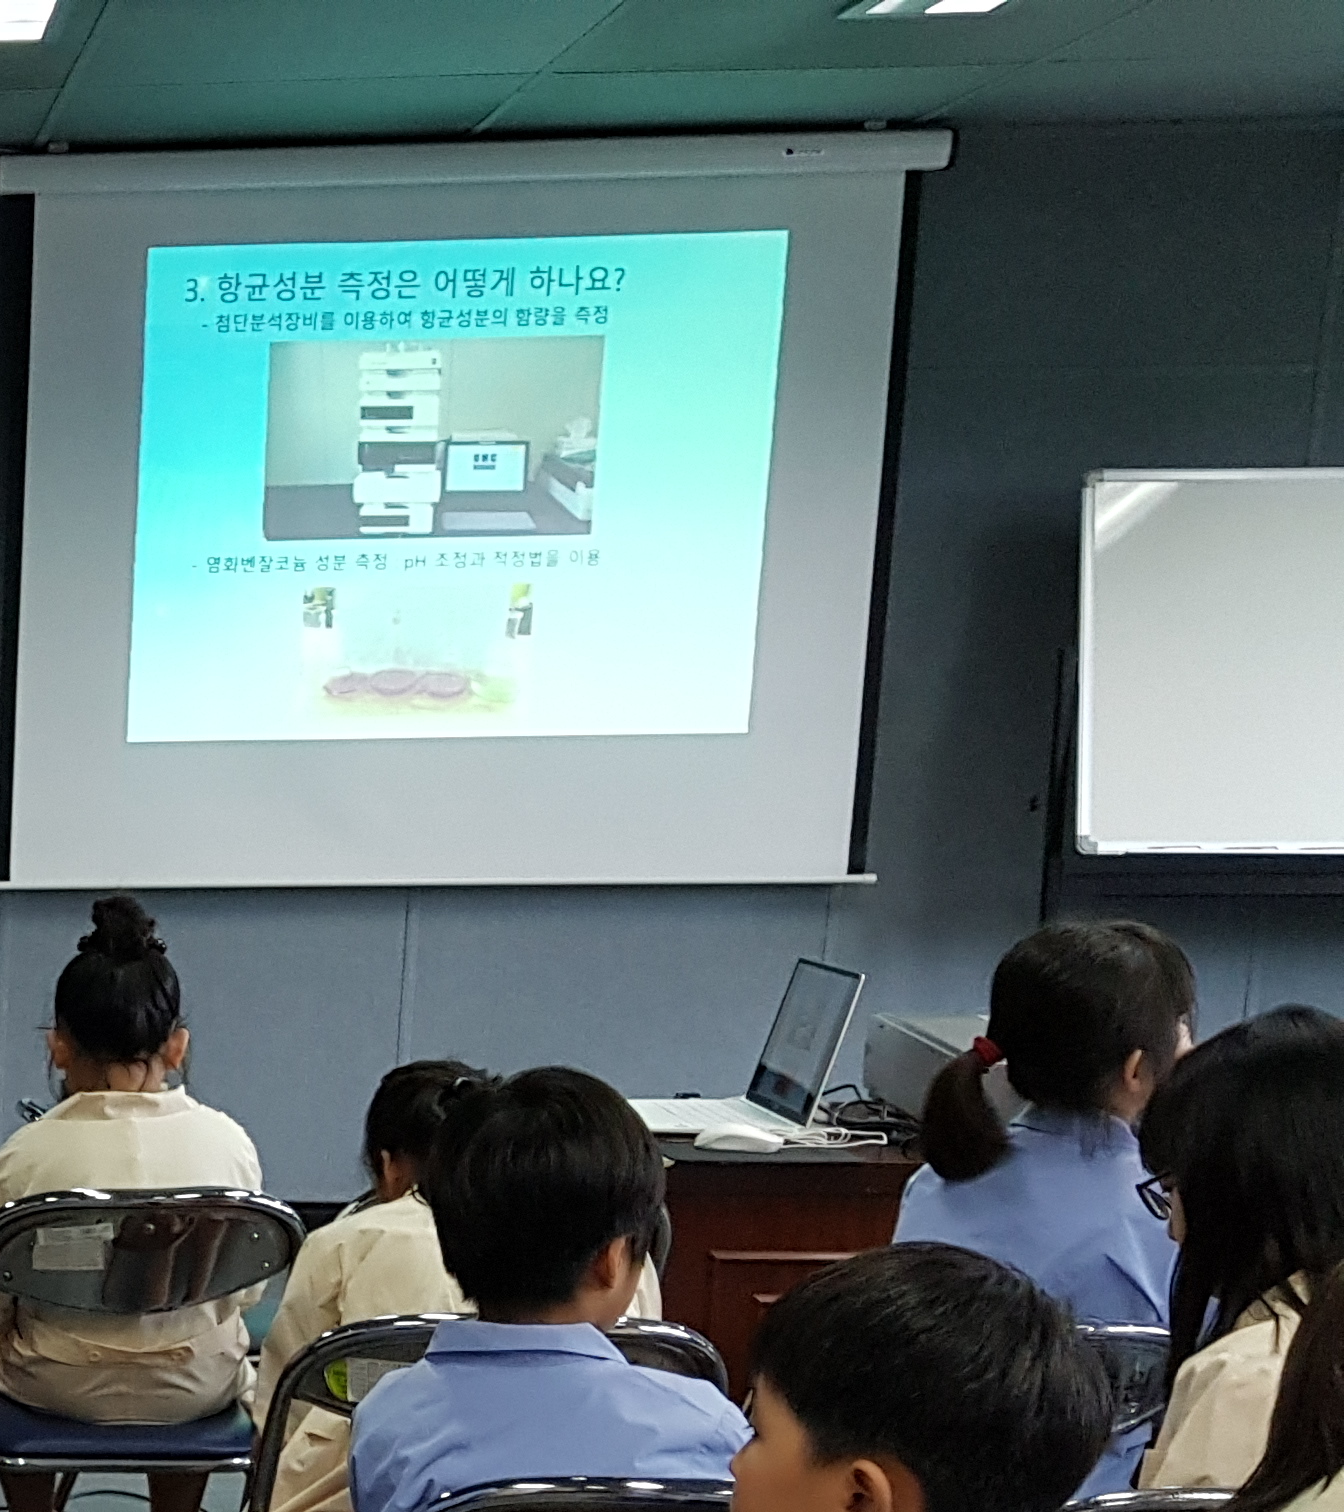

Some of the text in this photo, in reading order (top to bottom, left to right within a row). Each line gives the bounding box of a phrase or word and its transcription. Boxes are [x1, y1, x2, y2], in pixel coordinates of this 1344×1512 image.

[185, 265, 626, 303] 3. 항균성분 측정은 어떻게 하나요?
[215, 311, 335, 333] 첨단분석장비를
[343, 310, 412, 331] 이용하여
[420, 307, 509, 330] 항균성분의
[574, 305, 609, 325] 측정
[315, 554, 347, 572] 성분
[355, 553, 388, 571] 측정
[404, 555, 426, 571] pH
[435, 551, 486, 568] 조정과
[569, 549, 601, 567] 이용
